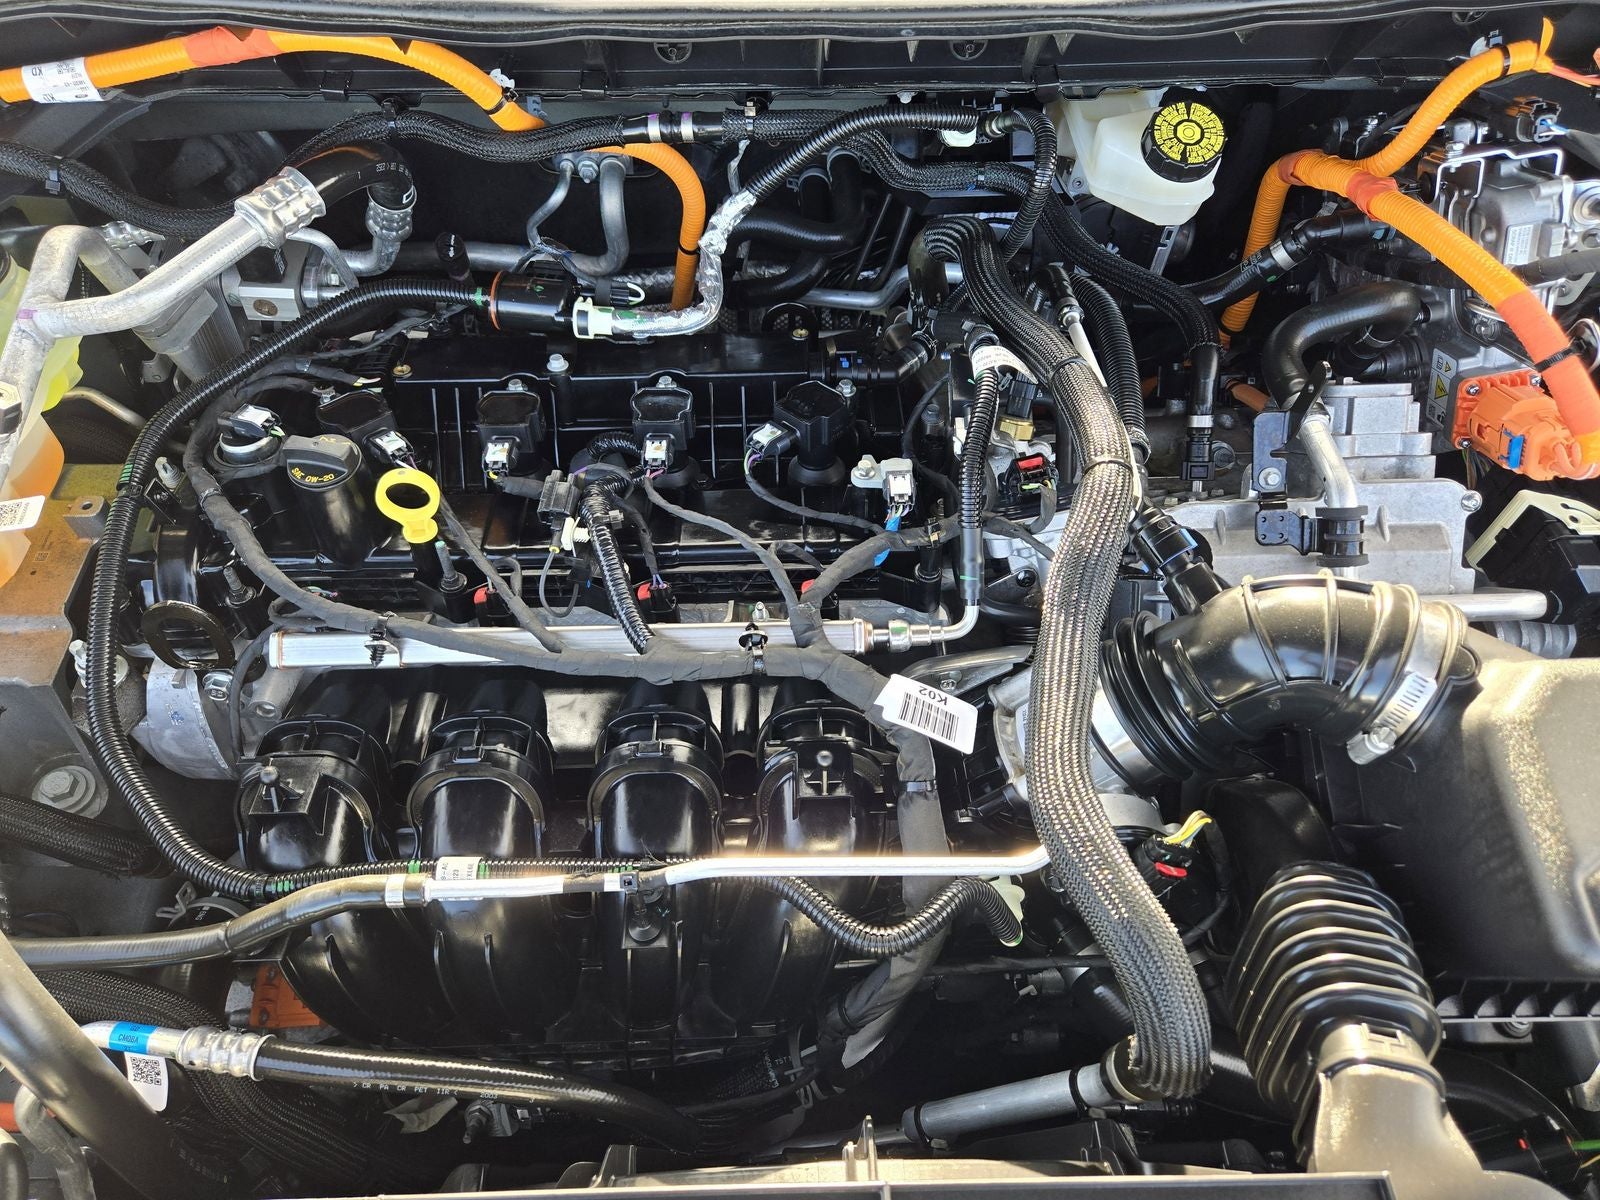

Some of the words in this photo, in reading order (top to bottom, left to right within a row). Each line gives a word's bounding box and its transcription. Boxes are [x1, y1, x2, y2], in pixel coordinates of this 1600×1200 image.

[291, 467, 305, 480] SAE
[918, 685, 948, 706] K02
[379, 1083, 390, 1091] PA
[414, 1086, 428, 1094] PET
